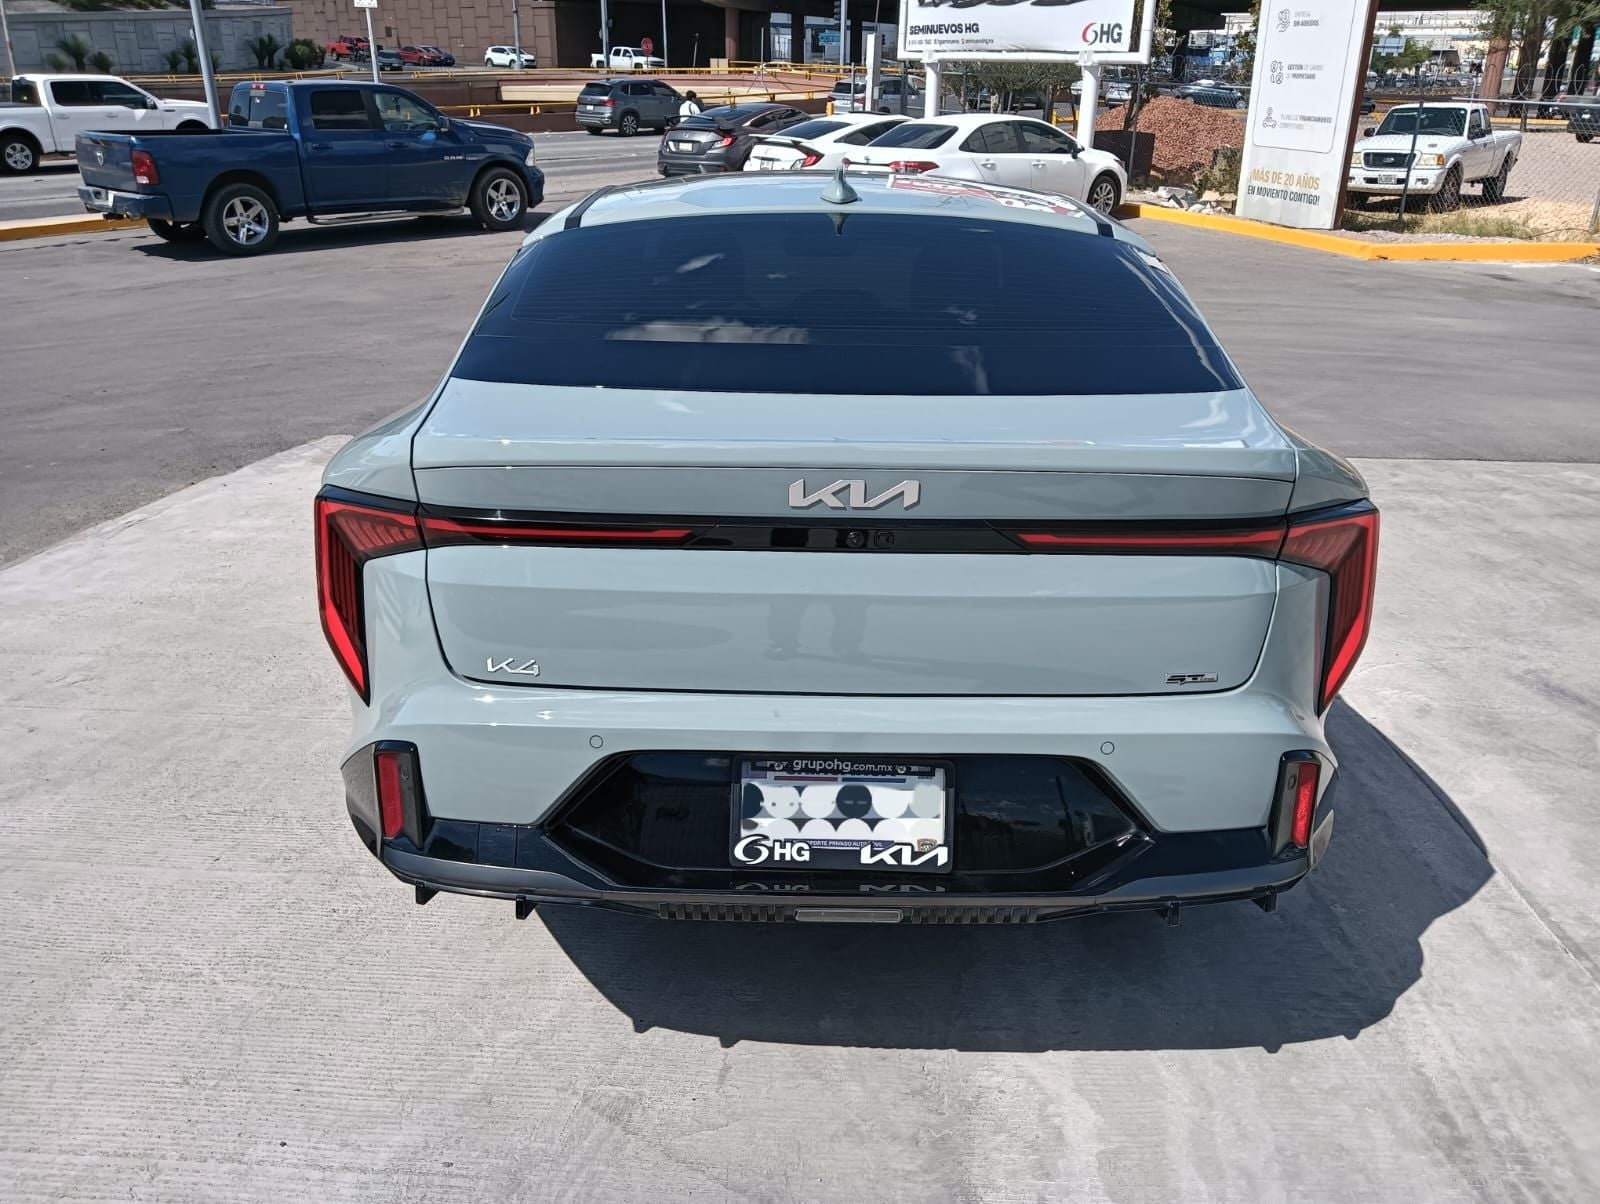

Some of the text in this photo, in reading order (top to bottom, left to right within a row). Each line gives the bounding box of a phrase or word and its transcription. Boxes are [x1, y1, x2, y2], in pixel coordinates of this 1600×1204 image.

[909, 22, 980, 36] SEMINUEVOS HG
[1098, 22, 1123, 44] HG
[1271, 170, 1283, 185] DE
[1283, 173, 1295, 187] 20
[1295, 173, 1321, 190] AÑOS
[1247, 184, 1321, 206] EN MOVIENTO CONTIGO!
[788, 478, 921, 511] KIA
[793, 758, 893, 773] grupohg.com.mx
[774, 841, 949, 867] HG KIA
